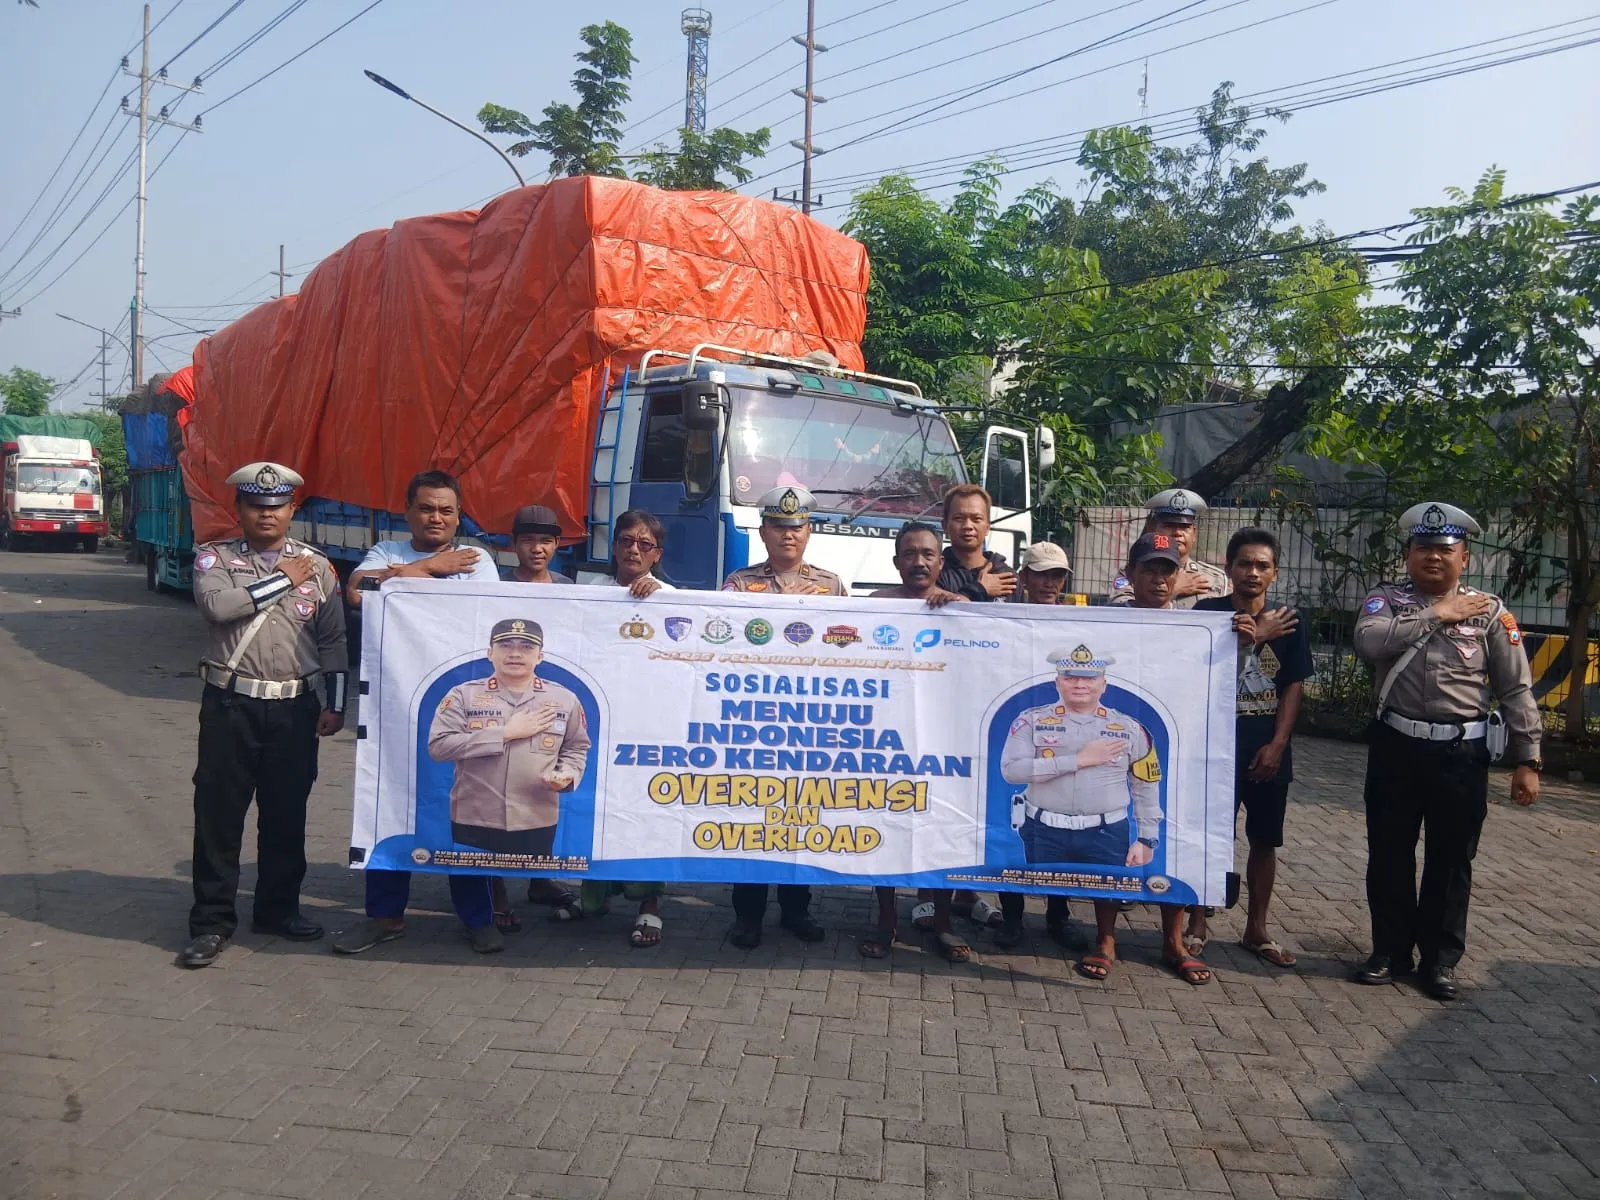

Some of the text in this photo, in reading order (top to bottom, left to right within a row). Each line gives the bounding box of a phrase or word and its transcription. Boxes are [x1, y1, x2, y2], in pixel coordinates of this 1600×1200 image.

[810, 523, 881, 537] ISSAN
[943, 638, 1000, 649] PELINDO
[705, 672, 890, 699] SOSIALISASI
[466, 709, 495, 717] WAHYU
[720, 699, 874, 726] MENUJU
[687, 722, 905, 751] INDONESIA
[1100, 730, 1130, 740] POLRI
[613, 743, 972, 778] ZERO KENDARAAN
[648, 772, 930, 812] OVERDIMENSI
[764, 805, 820, 828] DAN
[693, 820, 883, 854] OVERLOAD
